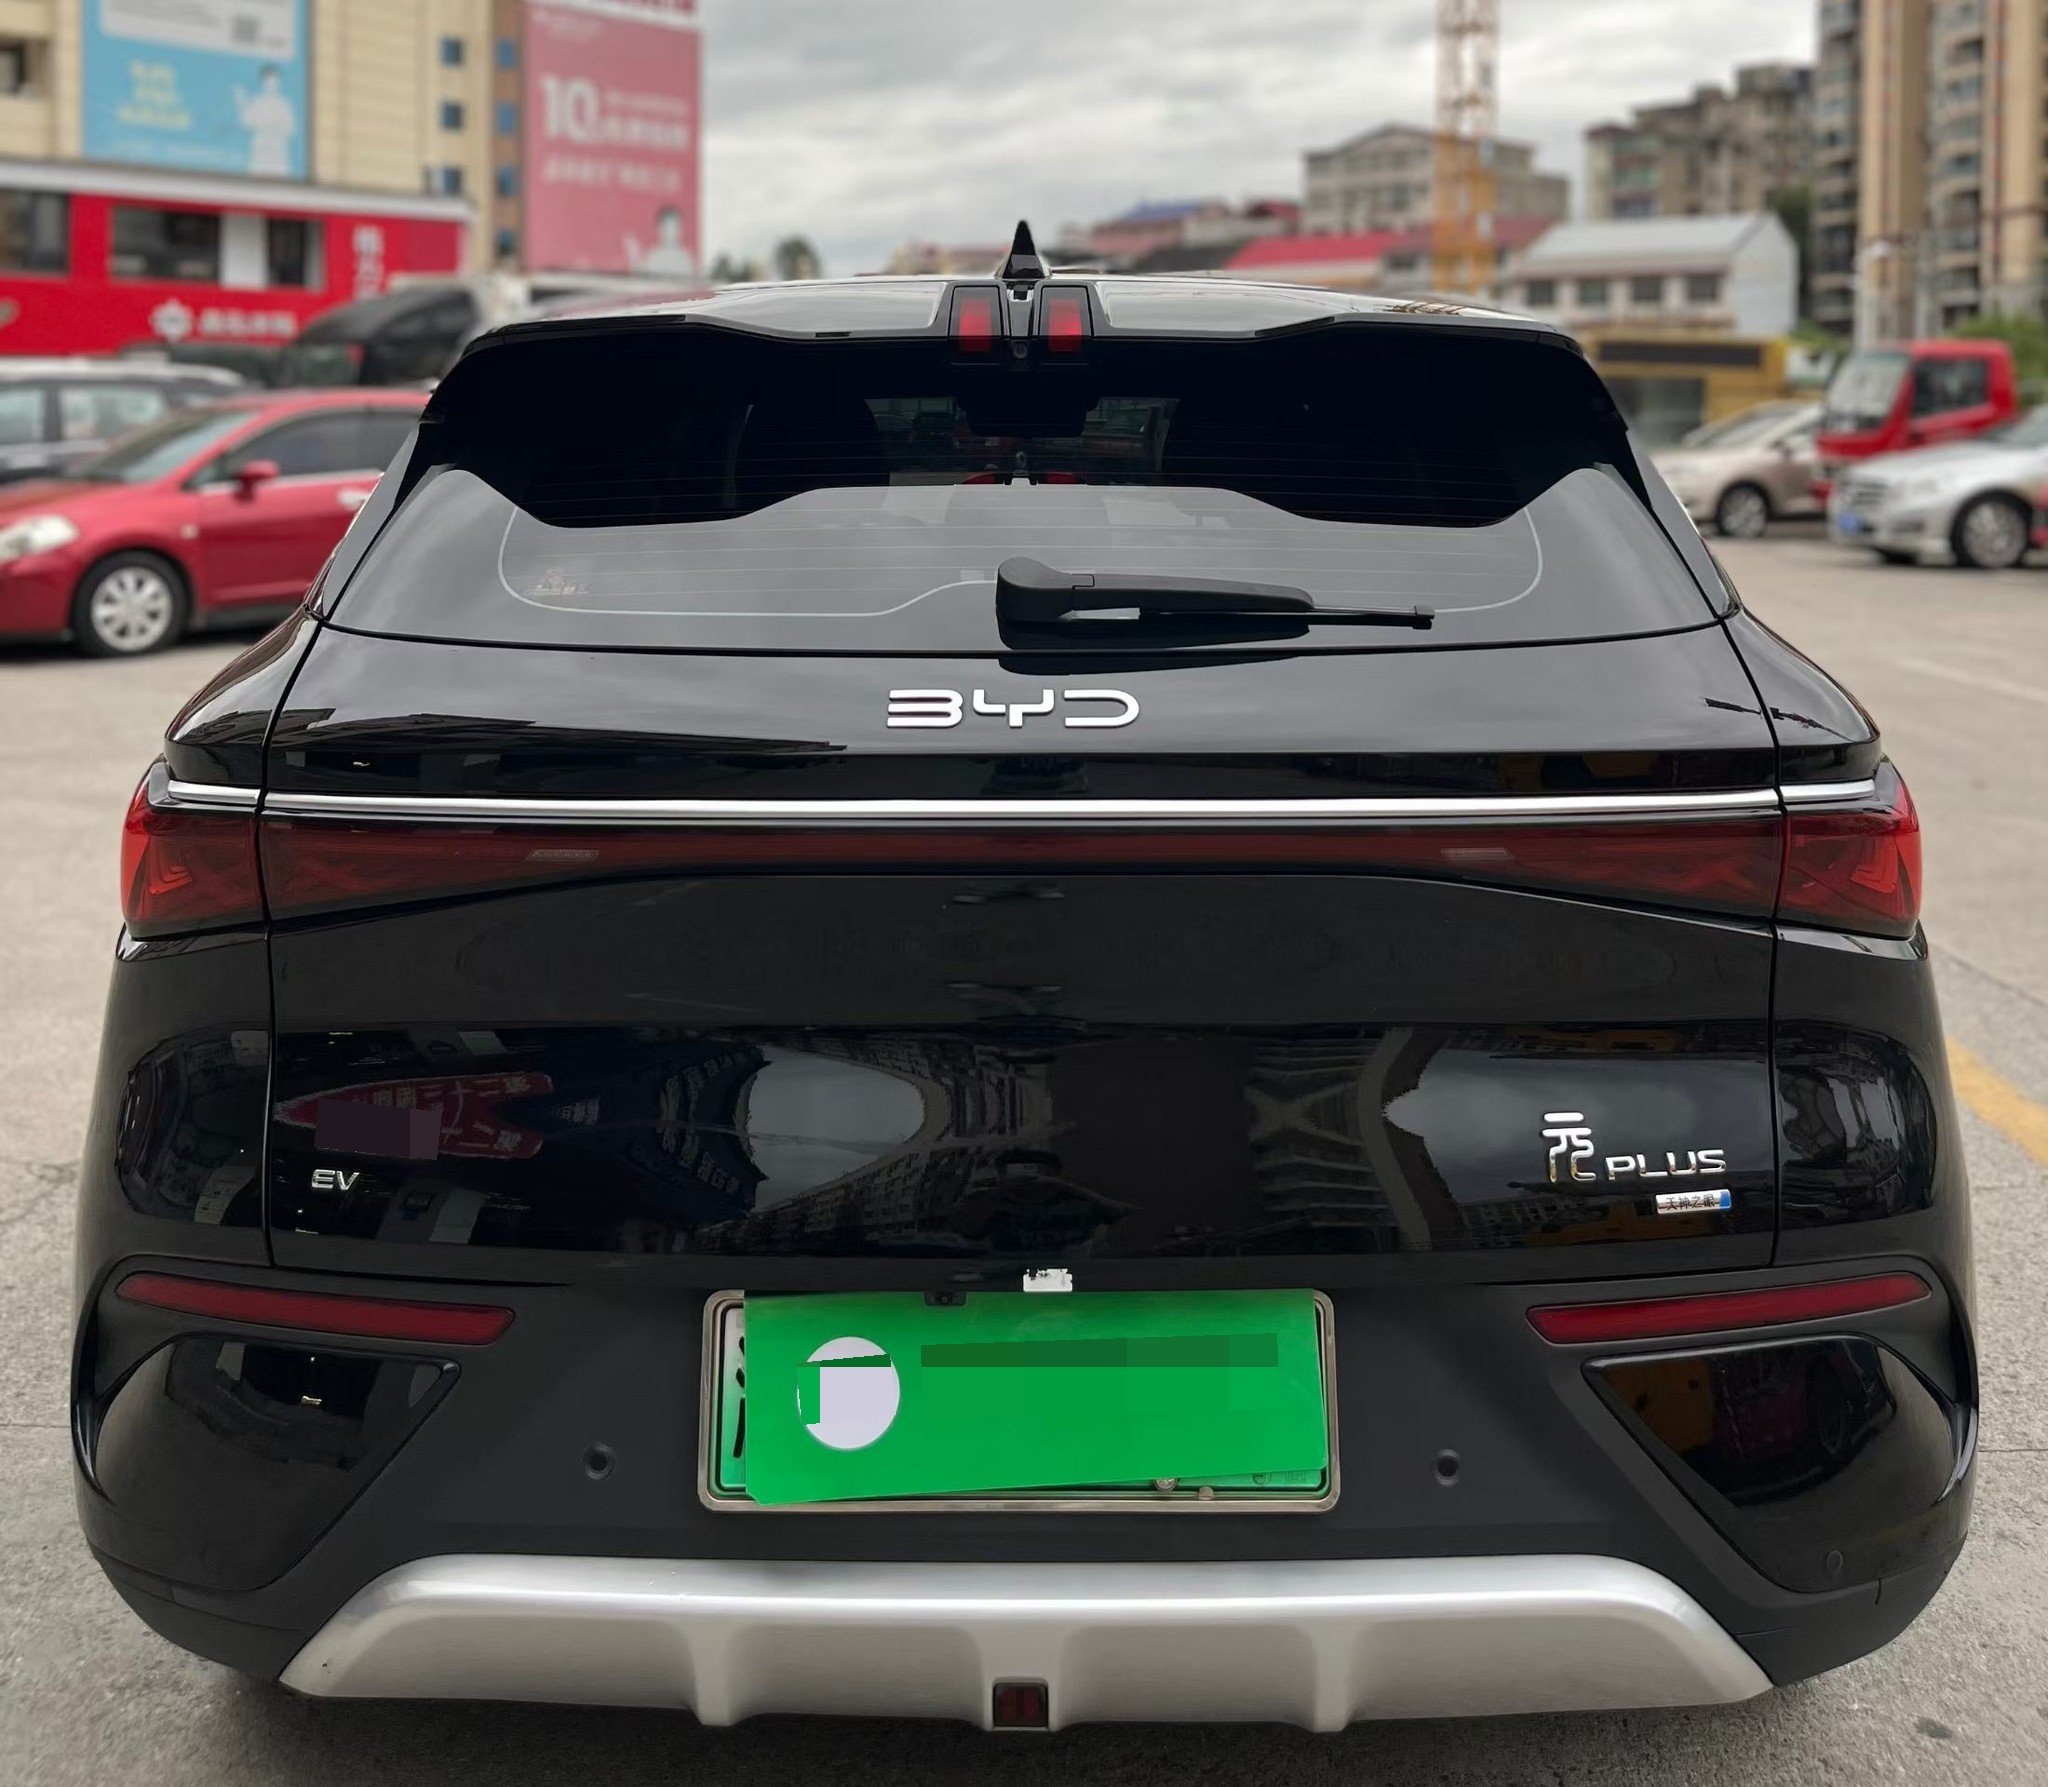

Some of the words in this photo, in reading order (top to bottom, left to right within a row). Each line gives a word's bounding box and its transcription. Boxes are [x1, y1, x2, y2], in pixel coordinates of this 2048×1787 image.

[886, 688, 1140, 728] BYD
[1541, 1111, 1597, 1184] 元
[1605, 1149, 1727, 1181] PLUS
[311, 1168, 360, 1190] EV
[1666, 1193, 1715, 1211] 天神之眼
